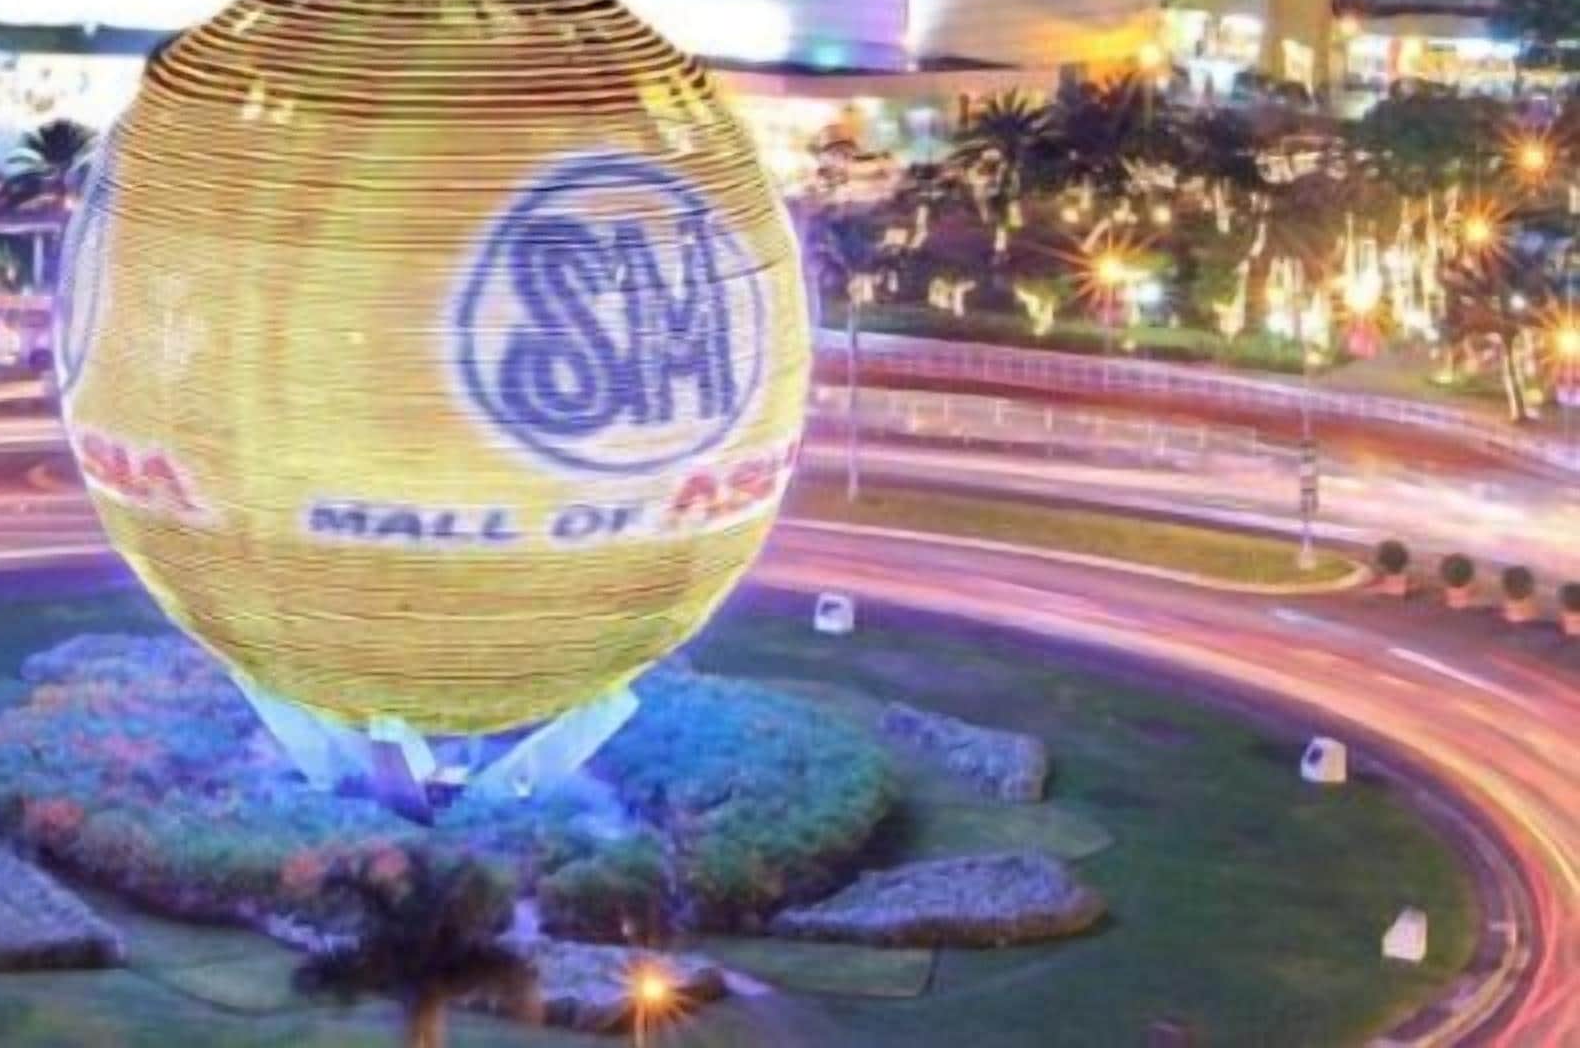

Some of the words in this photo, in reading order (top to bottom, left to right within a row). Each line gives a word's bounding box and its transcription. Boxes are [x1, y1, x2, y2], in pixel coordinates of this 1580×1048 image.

[499, 214, 738, 436] SM
[308, 504, 520, 540] MALL
[550, 502, 642, 539] OF
